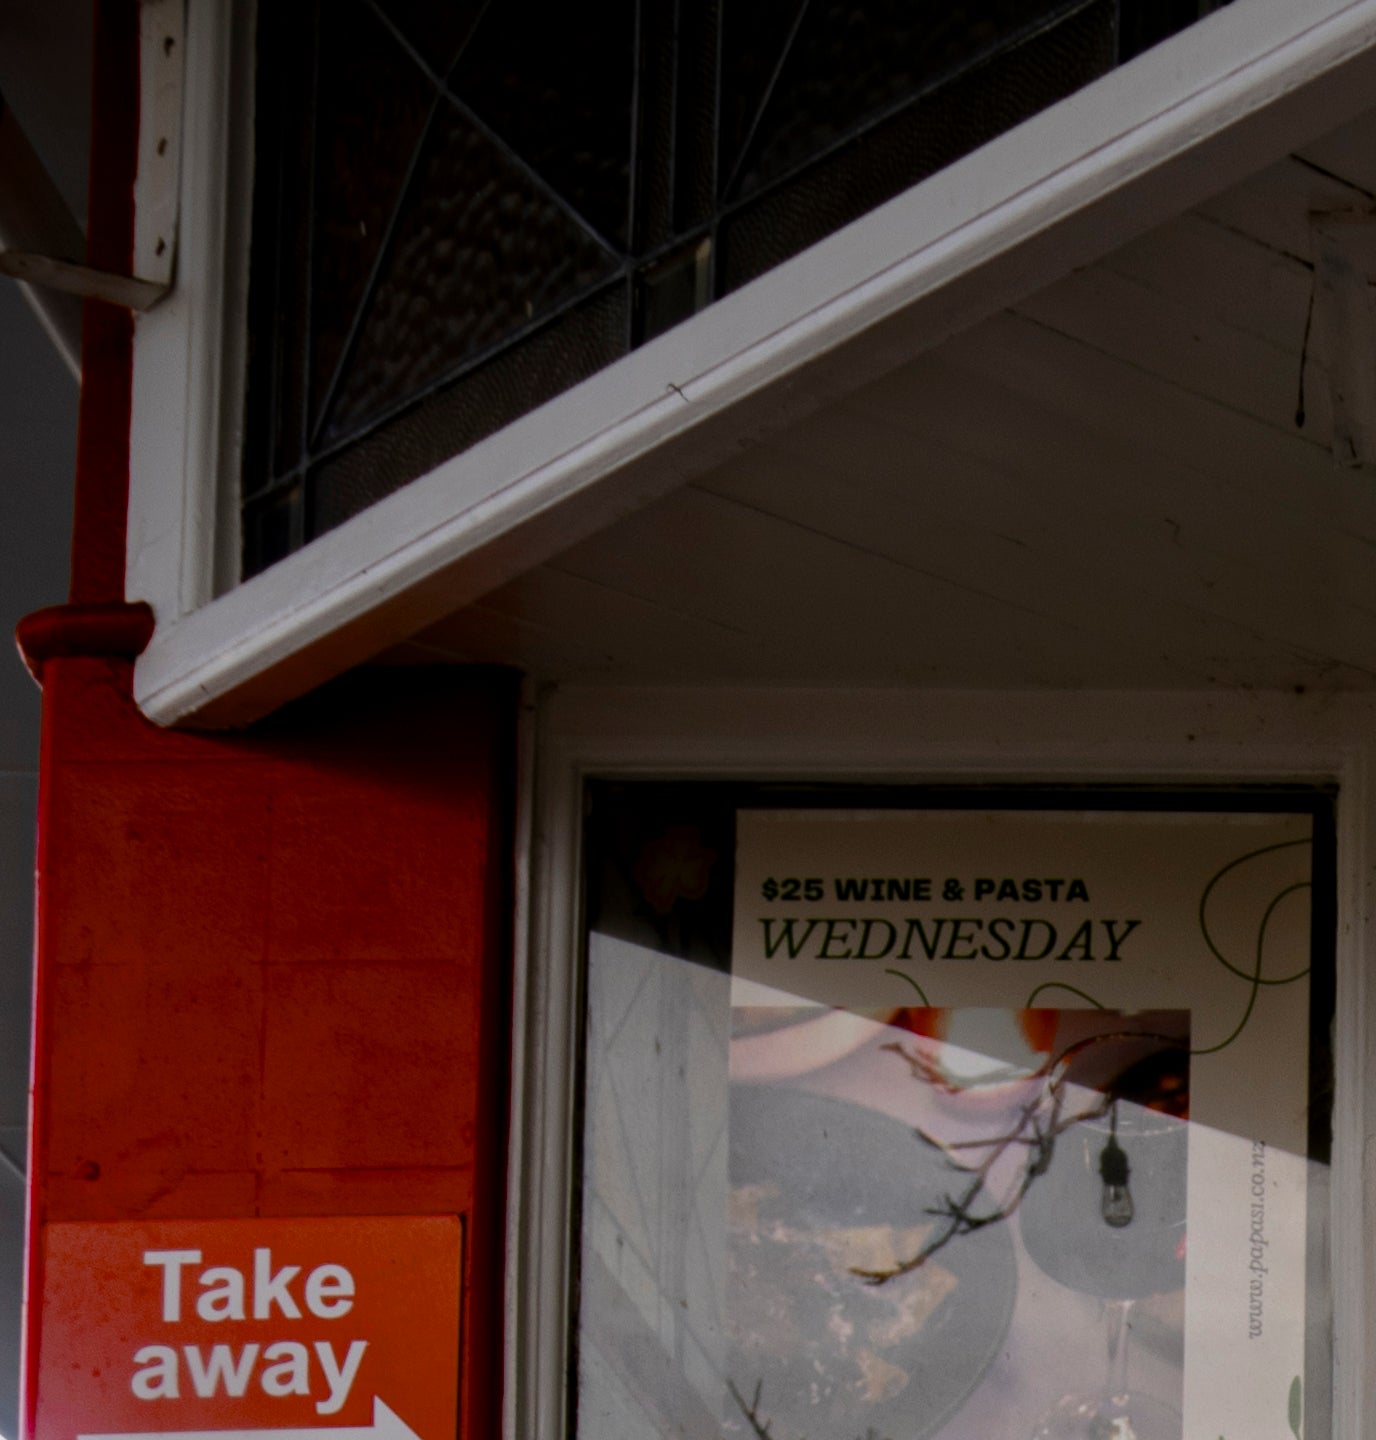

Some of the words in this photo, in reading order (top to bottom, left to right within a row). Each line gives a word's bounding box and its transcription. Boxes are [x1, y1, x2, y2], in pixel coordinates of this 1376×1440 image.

[761, 876, 824, 903] $25
[834, 877, 932, 902] WINE
[941, 877, 966, 902] &
[974, 877, 1090, 903] PASTA
[758, 917, 1142, 961] WEDNESDAY
[143, 1248, 356, 1322] Take
[131, 1340, 369, 1415] away
